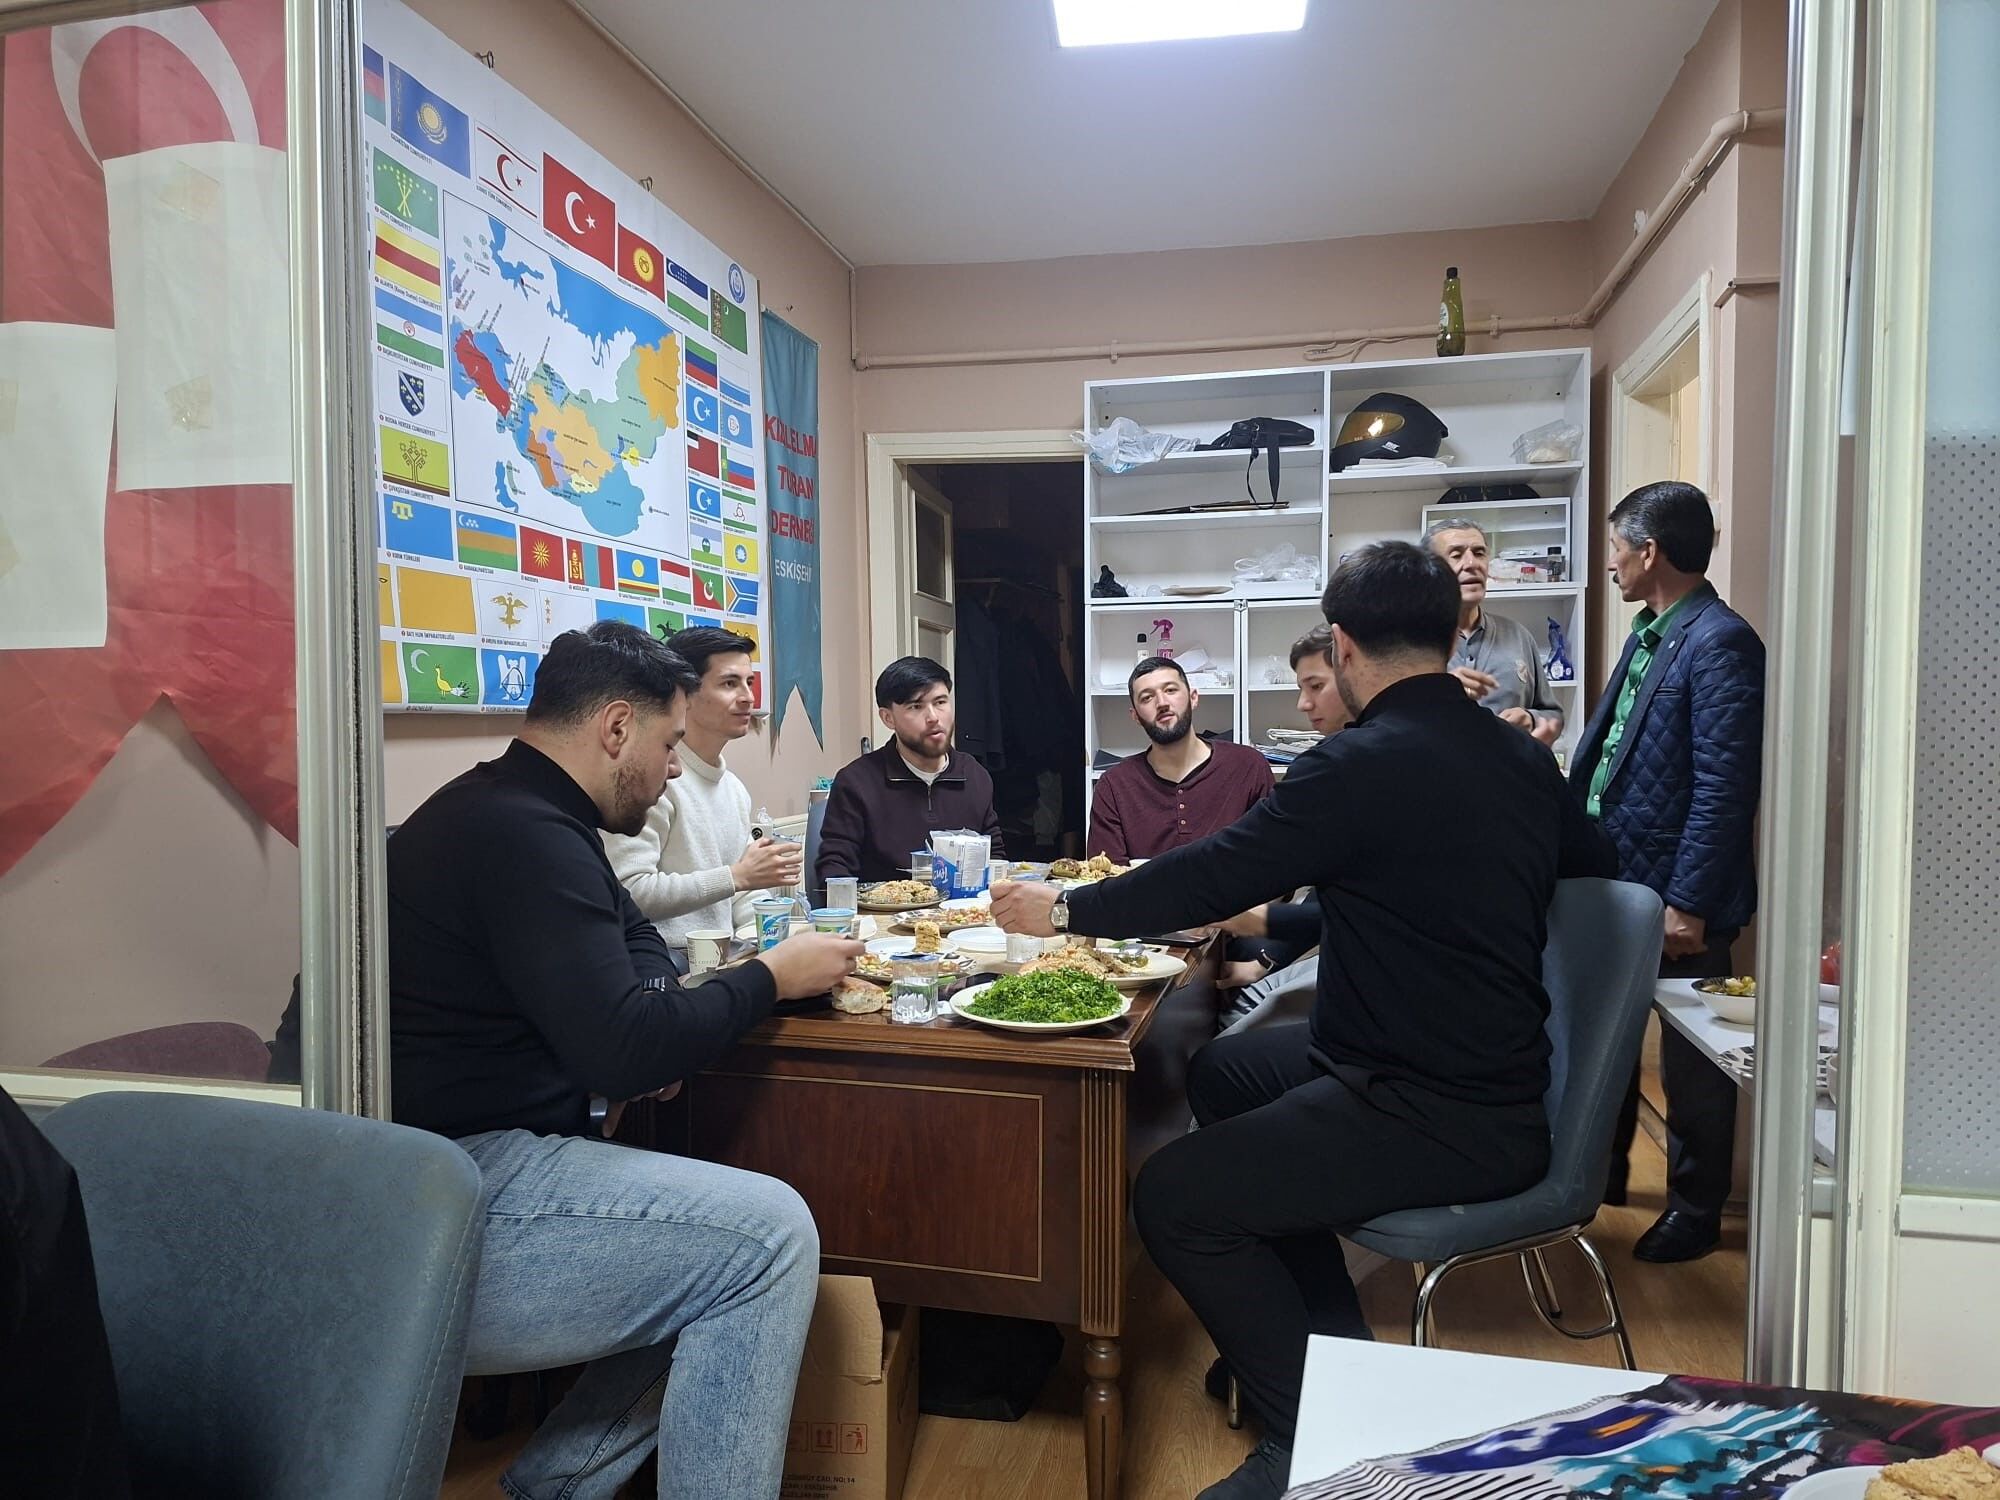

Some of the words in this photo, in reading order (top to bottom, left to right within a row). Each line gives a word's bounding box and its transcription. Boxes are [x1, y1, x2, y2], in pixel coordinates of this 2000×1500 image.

[765, 414, 817, 458] KIZILELM
[777, 464, 814, 500] TURAN
[769, 509, 815, 545] DERNEĞ
[774, 558, 813, 585] ESKİŞEHİ
